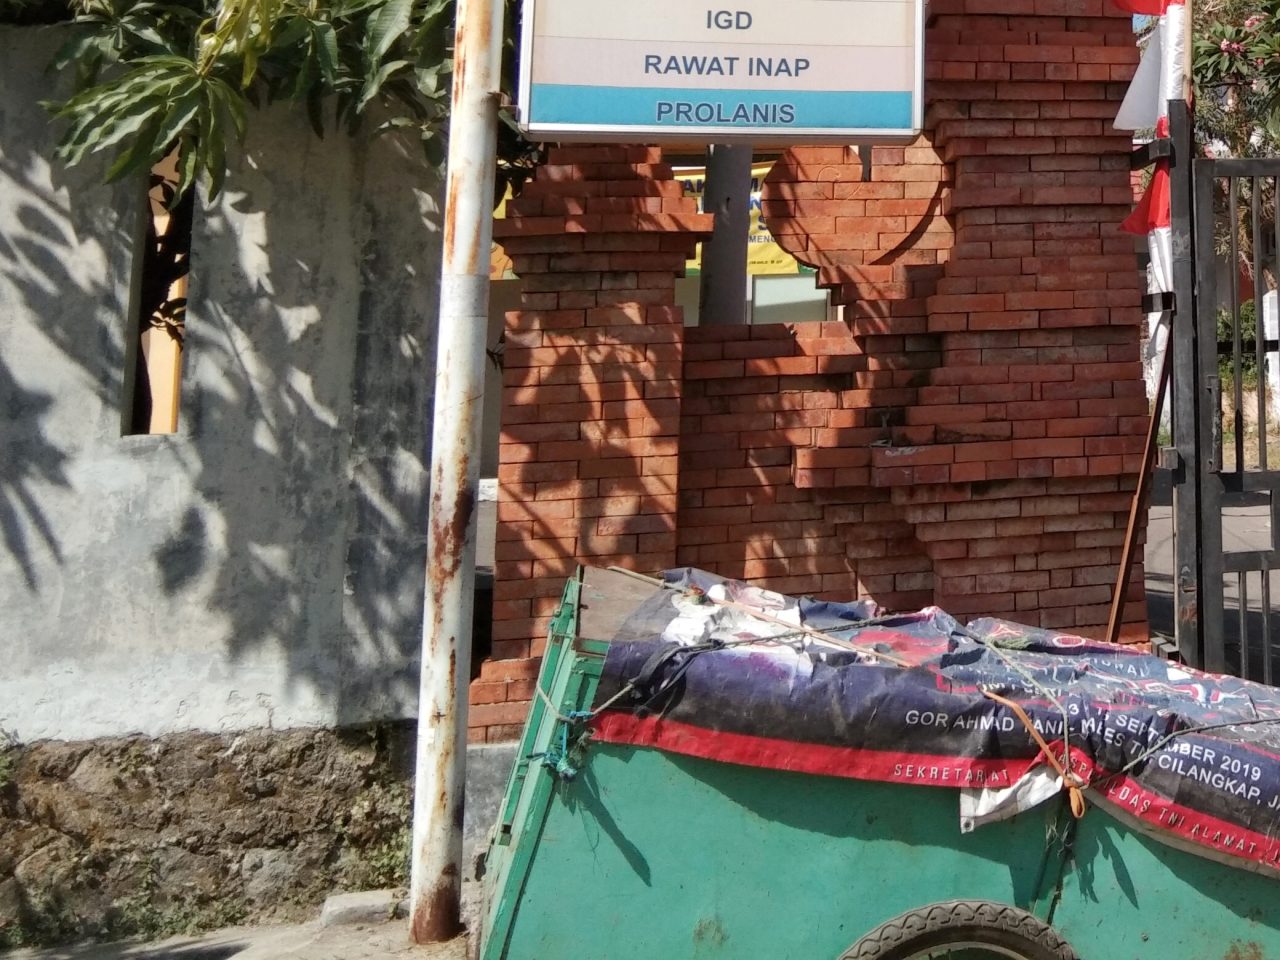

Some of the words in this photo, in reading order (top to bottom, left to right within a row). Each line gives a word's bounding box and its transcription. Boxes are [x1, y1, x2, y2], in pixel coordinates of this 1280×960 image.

[706, 10, 753, 31] IGD
[644, 54, 739, 76] RAWAT
[748, 57, 811, 77] INAP
[656, 101, 795, 124] PROLANIS
[906, 710, 948, 727] GOR
[1024, 720, 1064, 734] ANI
[1220, 755, 1261, 780] 2019
[1158, 754, 1261, 805] CILANGKAP,
